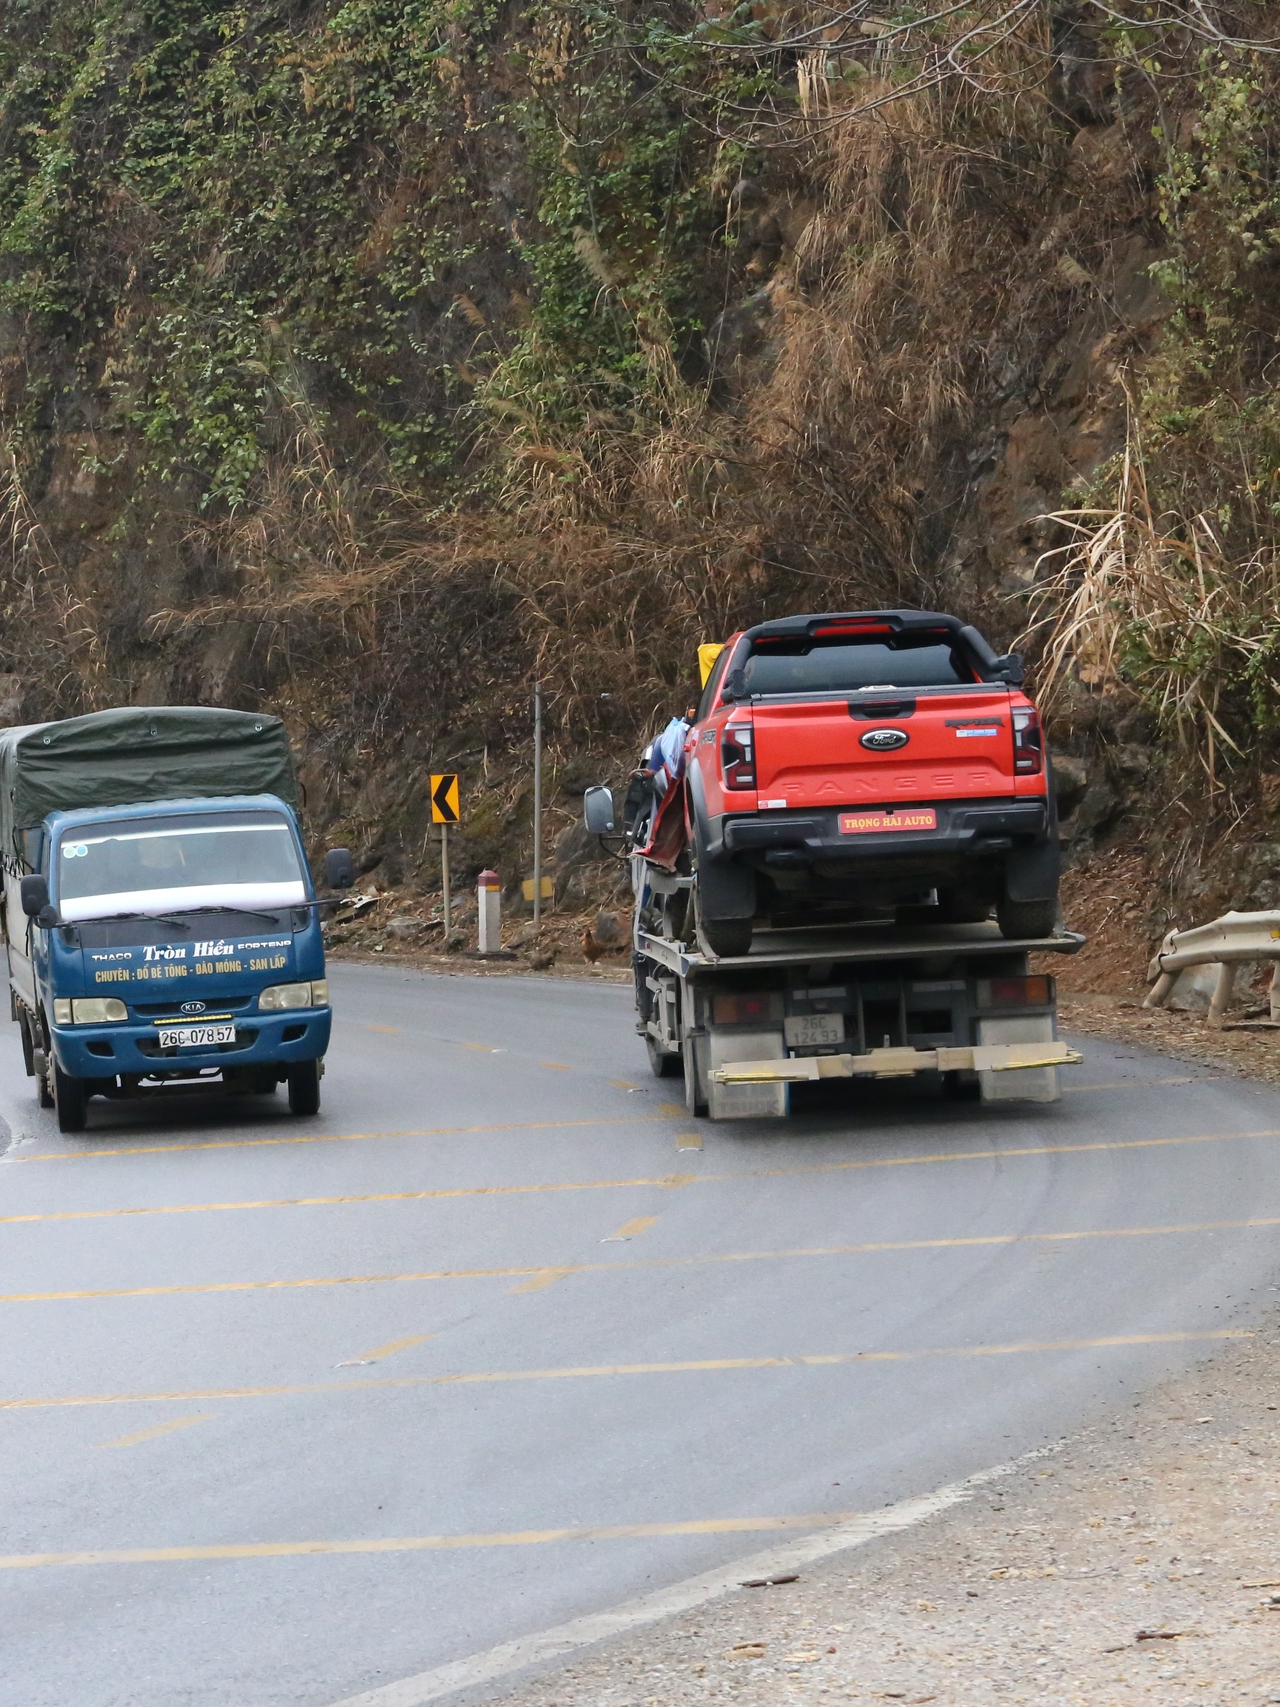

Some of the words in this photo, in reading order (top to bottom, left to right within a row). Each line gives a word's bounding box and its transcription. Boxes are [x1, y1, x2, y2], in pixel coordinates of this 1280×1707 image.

[780, 771, 992, 797] RANGER
[844, 818, 880, 830] TRỌNG
[904, 815, 933, 826] AUTO
[91, 952, 132, 962] THACO
[142, 945, 186, 961] Tròn
[95, 967, 130, 983] CHUYÊN
[150, 964, 162, 979] BÊ
[164, 963, 188, 978] TÔNG
[215, 959, 242, 974] MÓNG
[249, 957, 268, 971] SAN
[185, 1003, 202, 1012] KIA
[802, 1016, 826, 1030] 26C
[794, 1030, 838, 1044] 124.93
